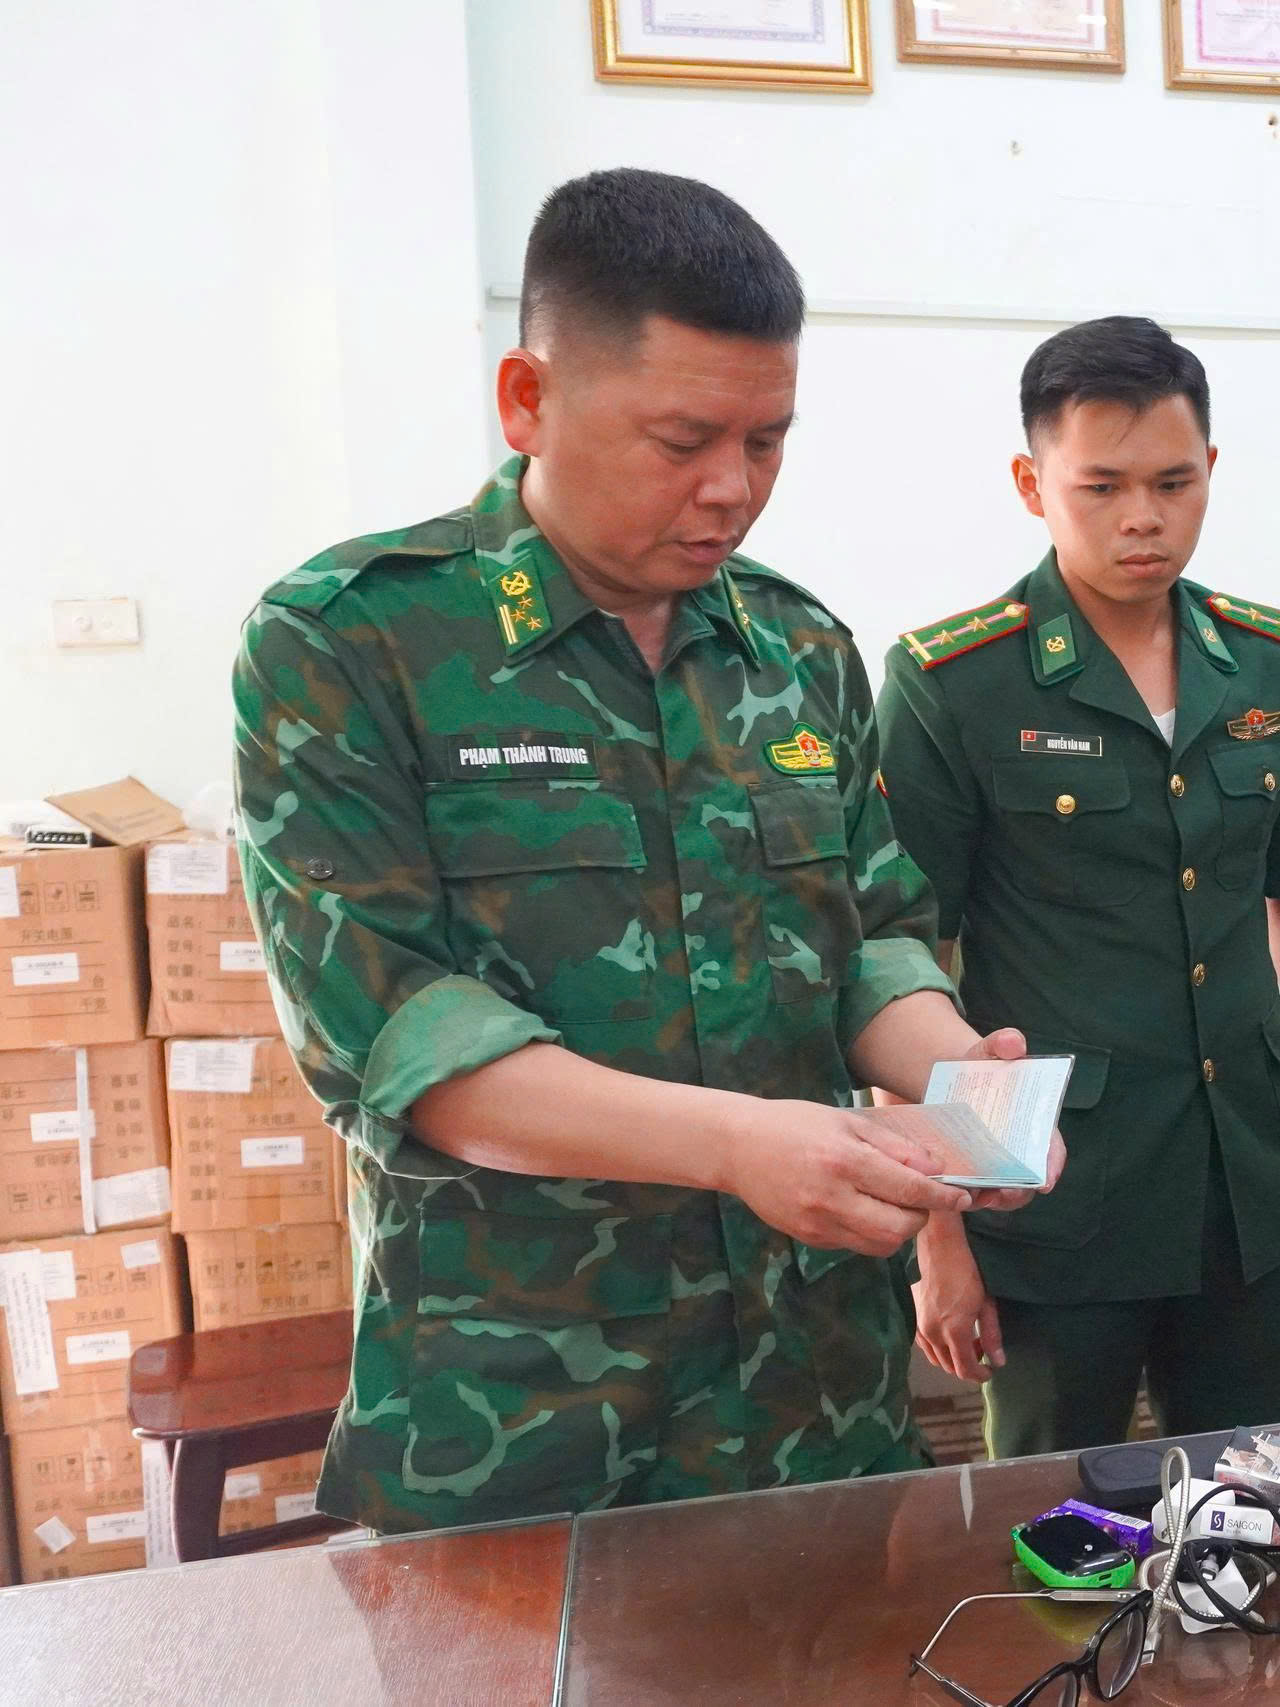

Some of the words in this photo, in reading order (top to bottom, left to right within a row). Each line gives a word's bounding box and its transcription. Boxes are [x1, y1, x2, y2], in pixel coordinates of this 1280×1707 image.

[459, 748, 501, 769] PHẠM
[502, 743, 547, 765] THÀNH
[547, 746, 589, 764] TRUNG
[1226, 1518, 1262, 1532] SAIGON
